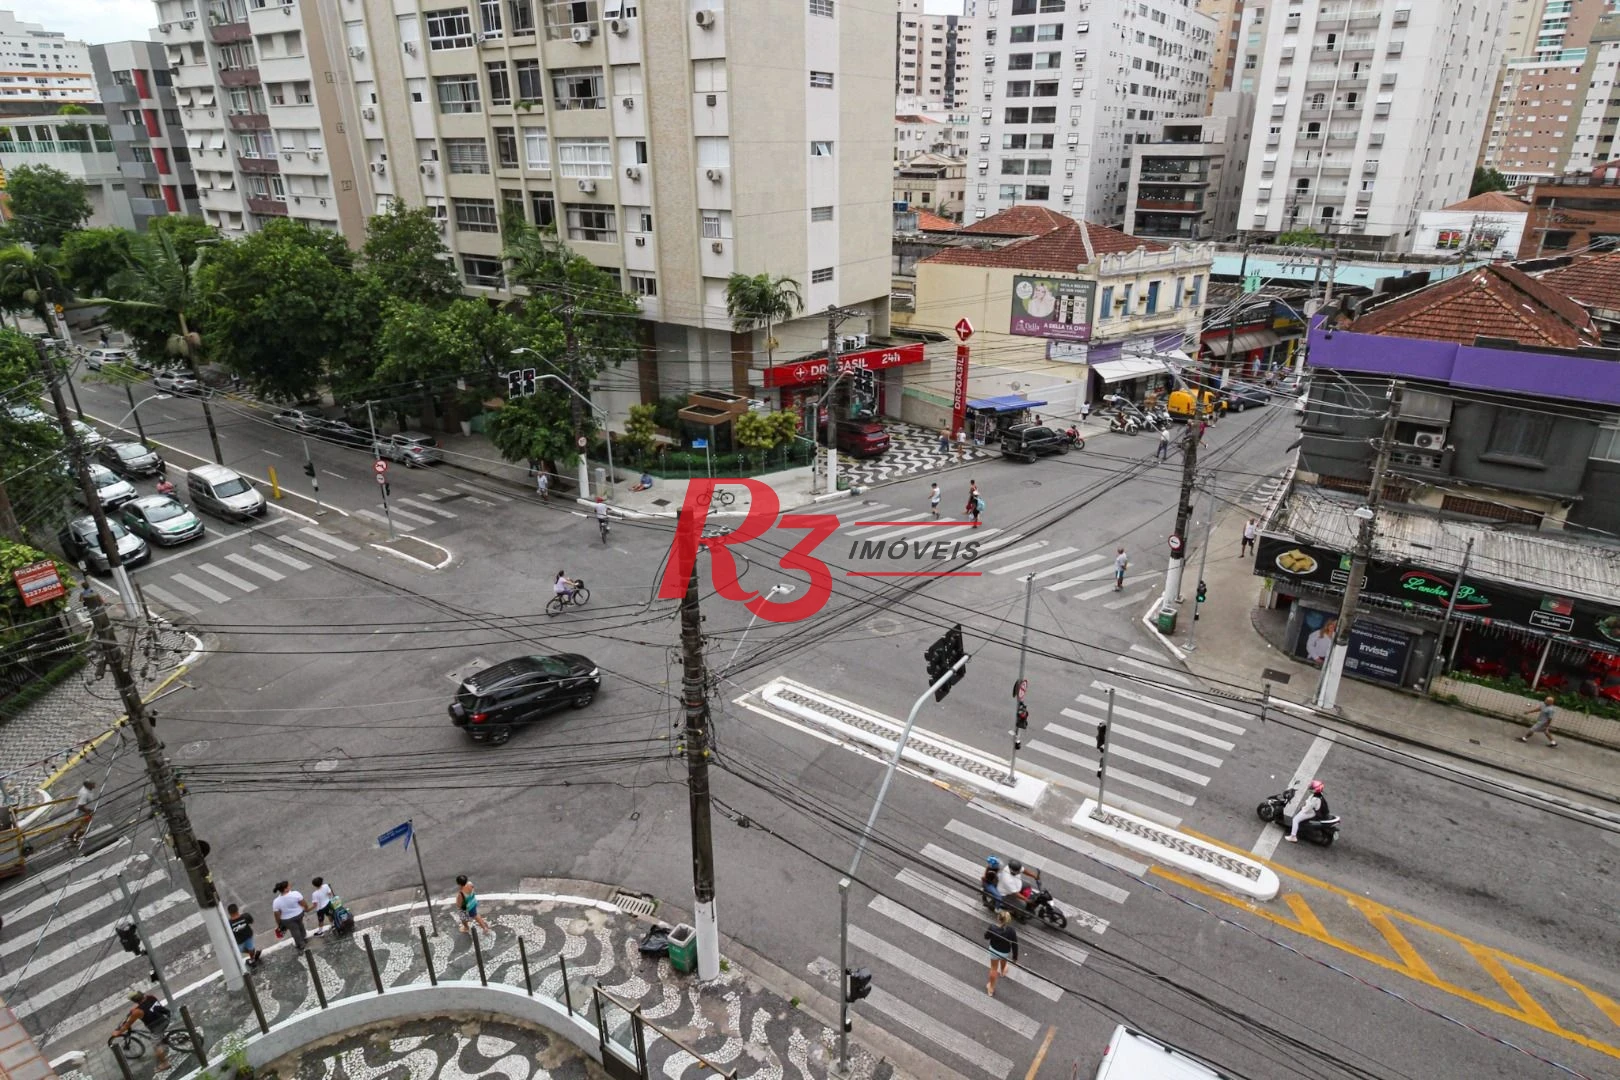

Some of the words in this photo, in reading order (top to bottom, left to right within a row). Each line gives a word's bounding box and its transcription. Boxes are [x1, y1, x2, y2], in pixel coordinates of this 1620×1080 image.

[811, 358, 869, 376] DRGASIL
[881, 352, 901, 365] 24h
[954, 356, 966, 410] DROGASIL
[1359, 642, 1389, 657] invista
